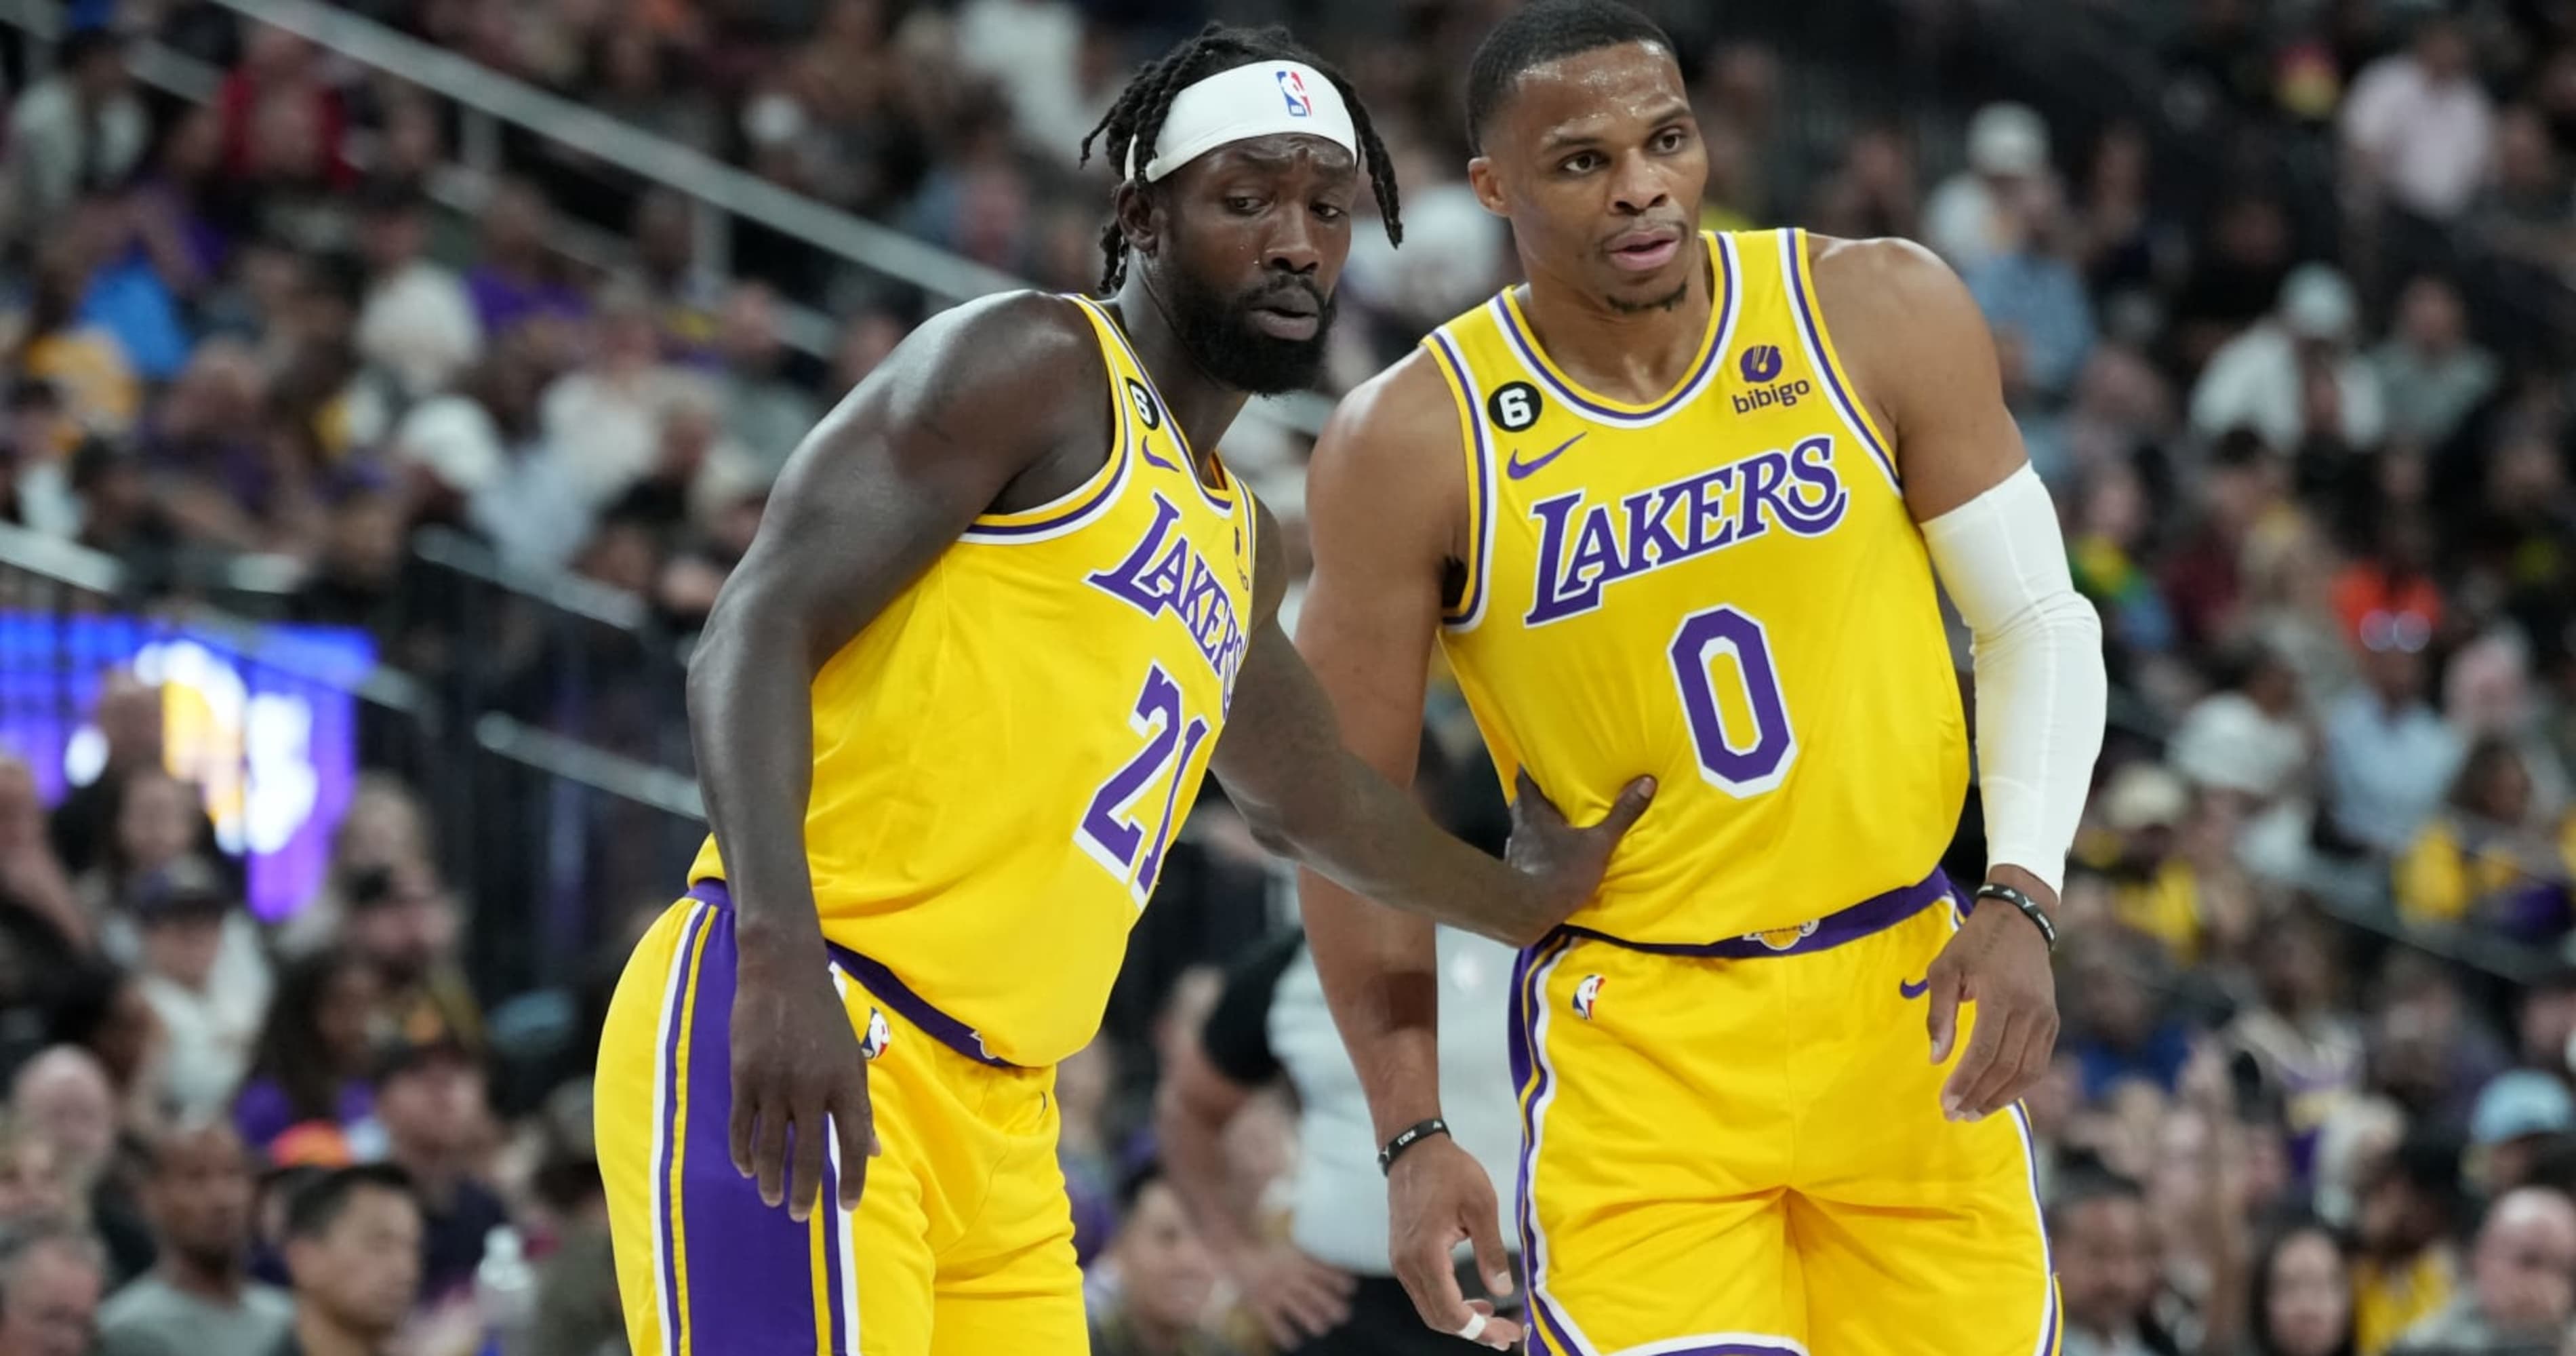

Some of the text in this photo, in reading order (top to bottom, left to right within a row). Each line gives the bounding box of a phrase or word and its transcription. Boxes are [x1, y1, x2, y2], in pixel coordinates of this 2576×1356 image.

[1498, 387, 1532, 428] 6
[1731, 380, 1810, 415] bibigo
[1524, 434, 1850, 629] LAKERS
[1072, 658, 1211, 912] 21
[1666, 603, 1798, 800] 0
